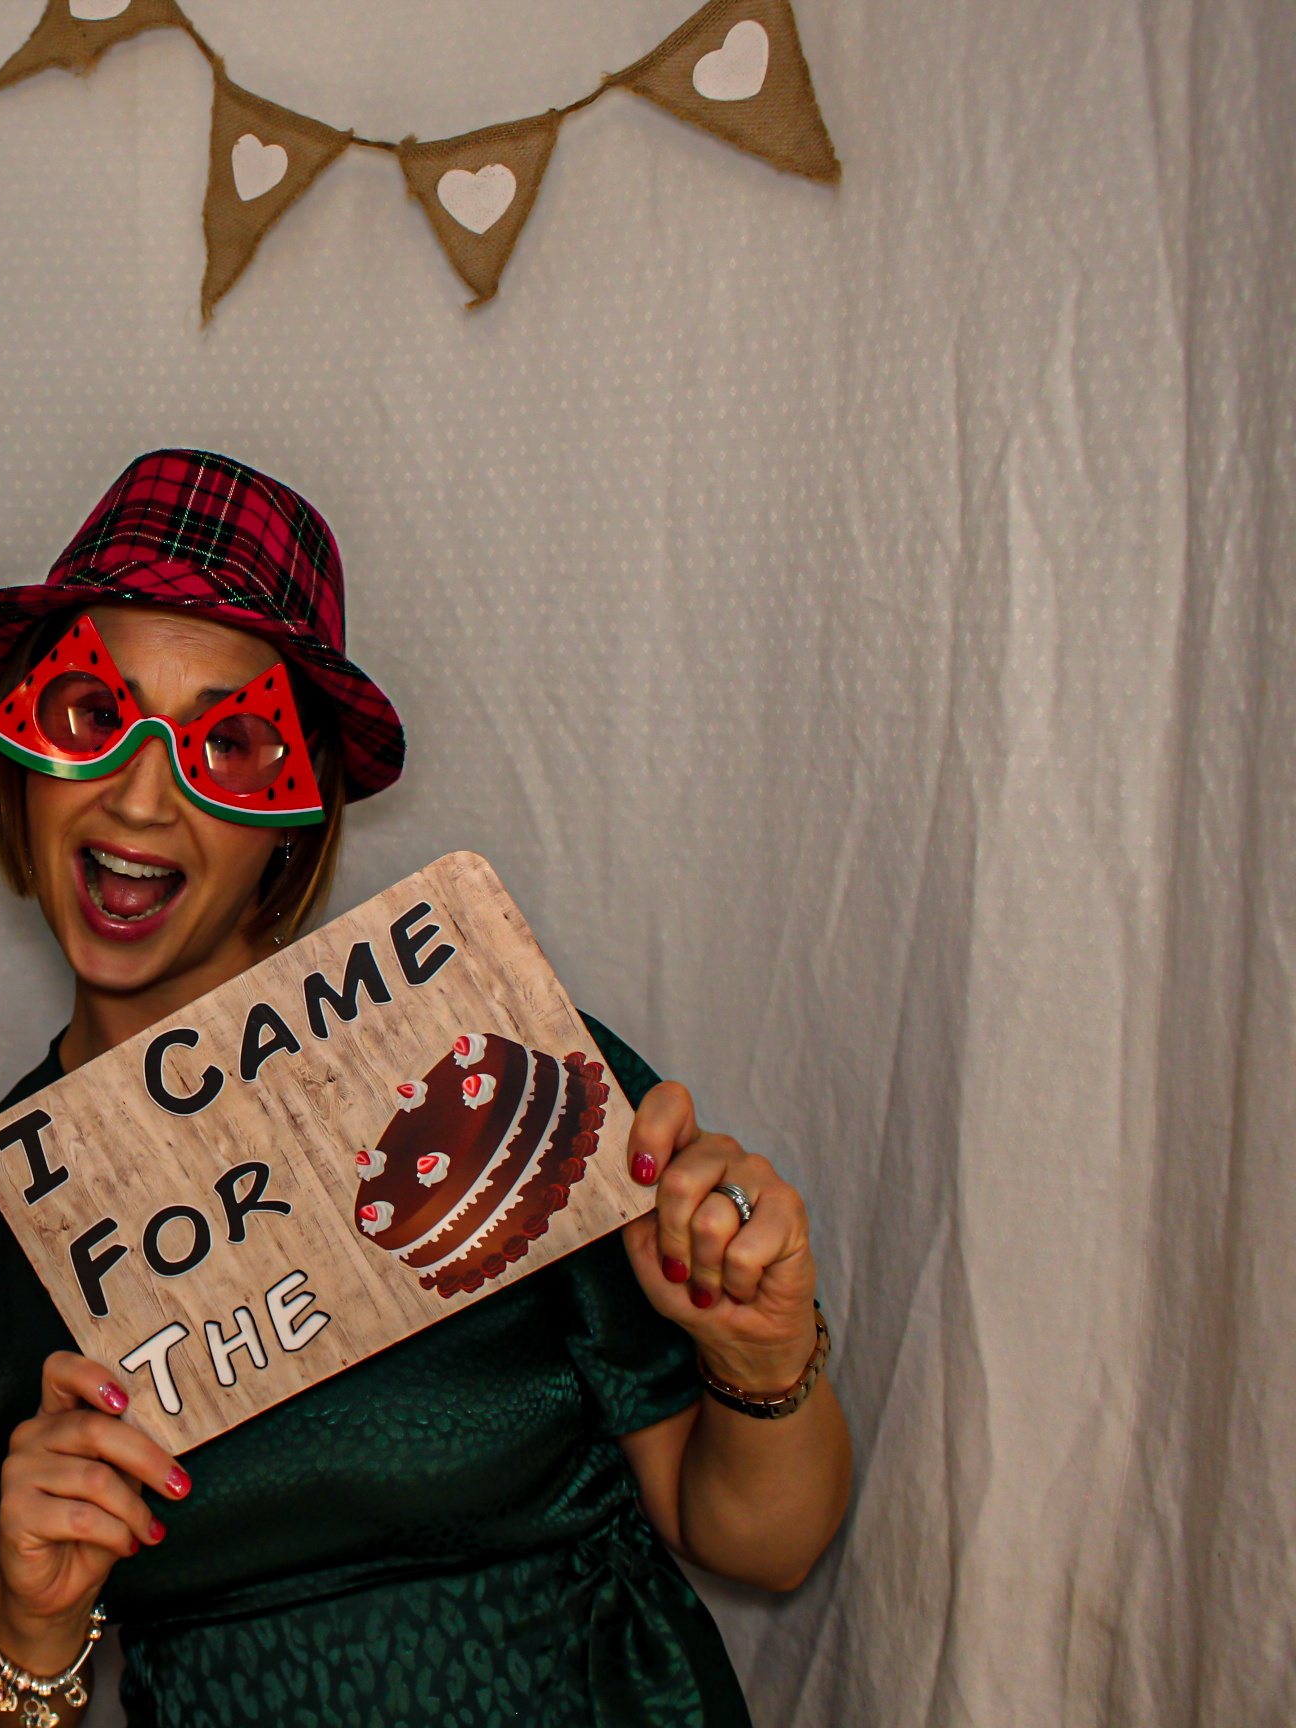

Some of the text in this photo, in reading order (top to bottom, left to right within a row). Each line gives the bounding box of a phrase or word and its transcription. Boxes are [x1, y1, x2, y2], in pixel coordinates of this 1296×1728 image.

[144, 901, 456, 1116] CAME
[69, 1161, 292, 1318] FOR
[119, 1269, 331, 1415] THE
